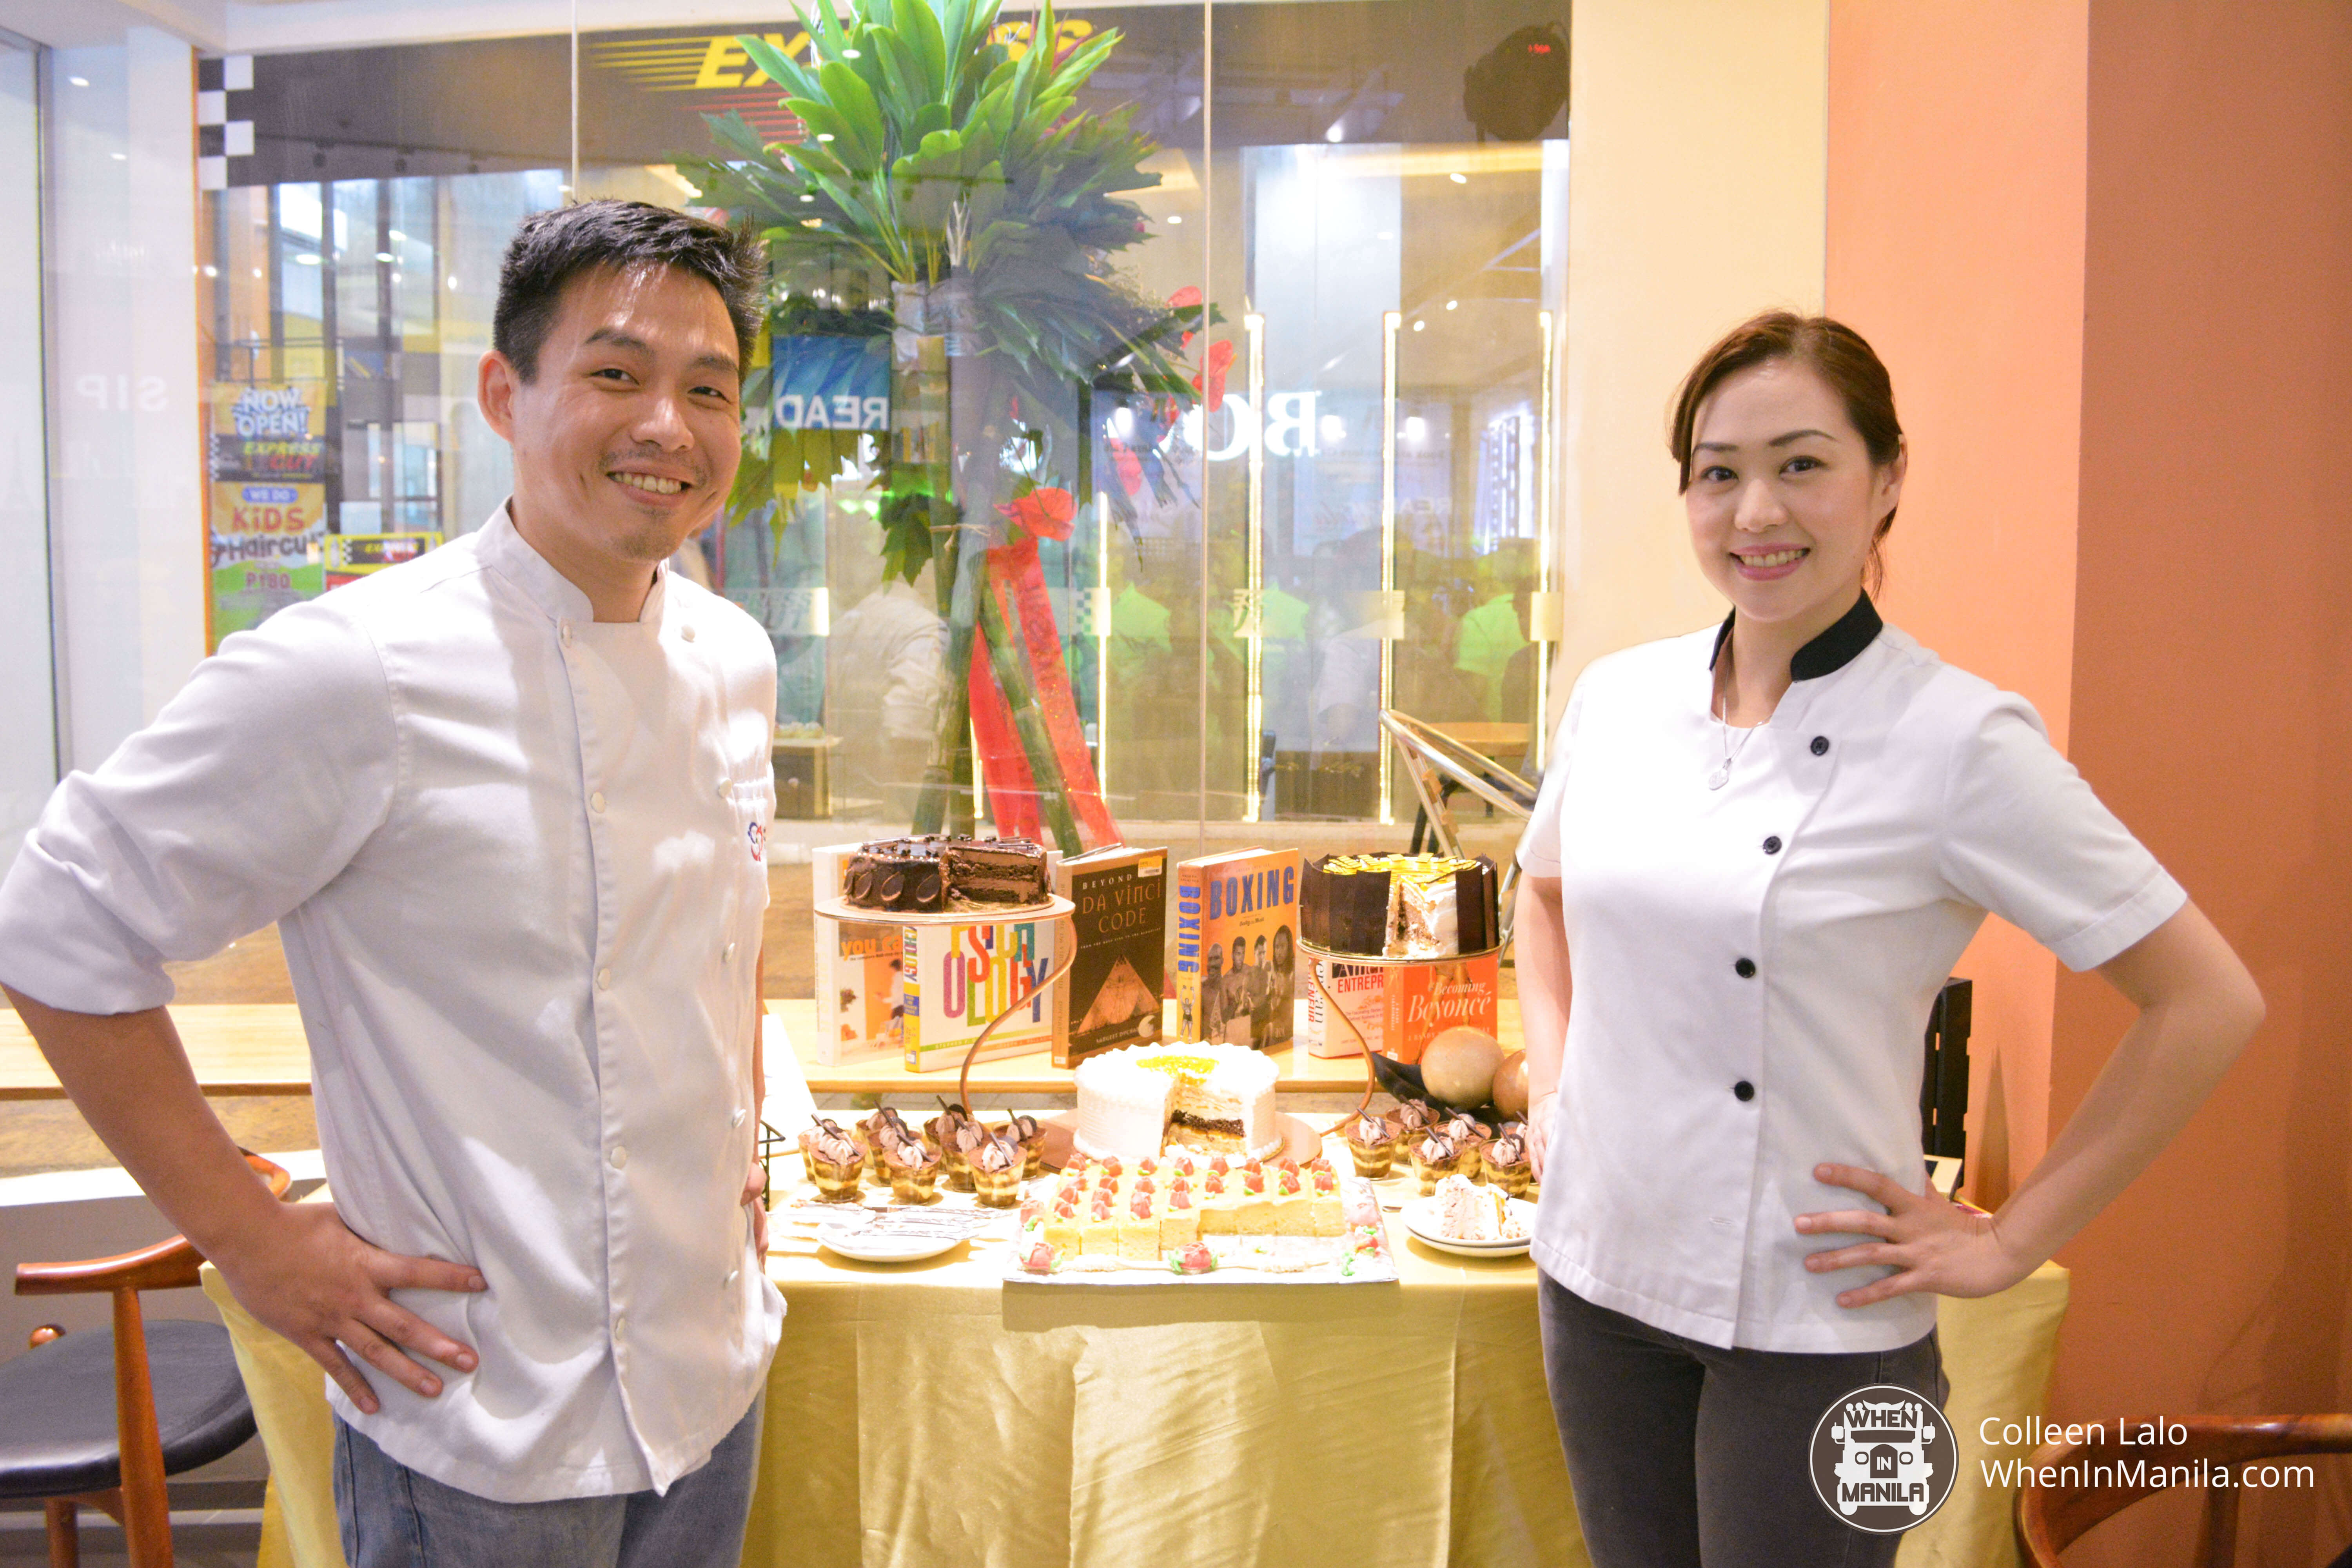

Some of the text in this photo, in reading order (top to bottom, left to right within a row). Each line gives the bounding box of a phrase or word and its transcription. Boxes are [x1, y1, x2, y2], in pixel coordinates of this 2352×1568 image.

[695, 19, 1093, 88] EXSS
[241, 387, 303, 412] NOW
[238, 412, 309, 437] OPEN!
[1082, 874, 1132, 890] BEYOND
[1209, 866, 1294, 920] BOXING
[1083, 894, 1106, 914] DA
[1098, 907, 1147, 933] CODE
[1178, 885, 1201, 973] BOXING
[840, 935, 903, 962] you ca
[1338, 974, 1383, 993] ENTREPR
[1433, 981, 1486, 996] Becoming
[1407, 991, 1492, 1023] Beyoncé
